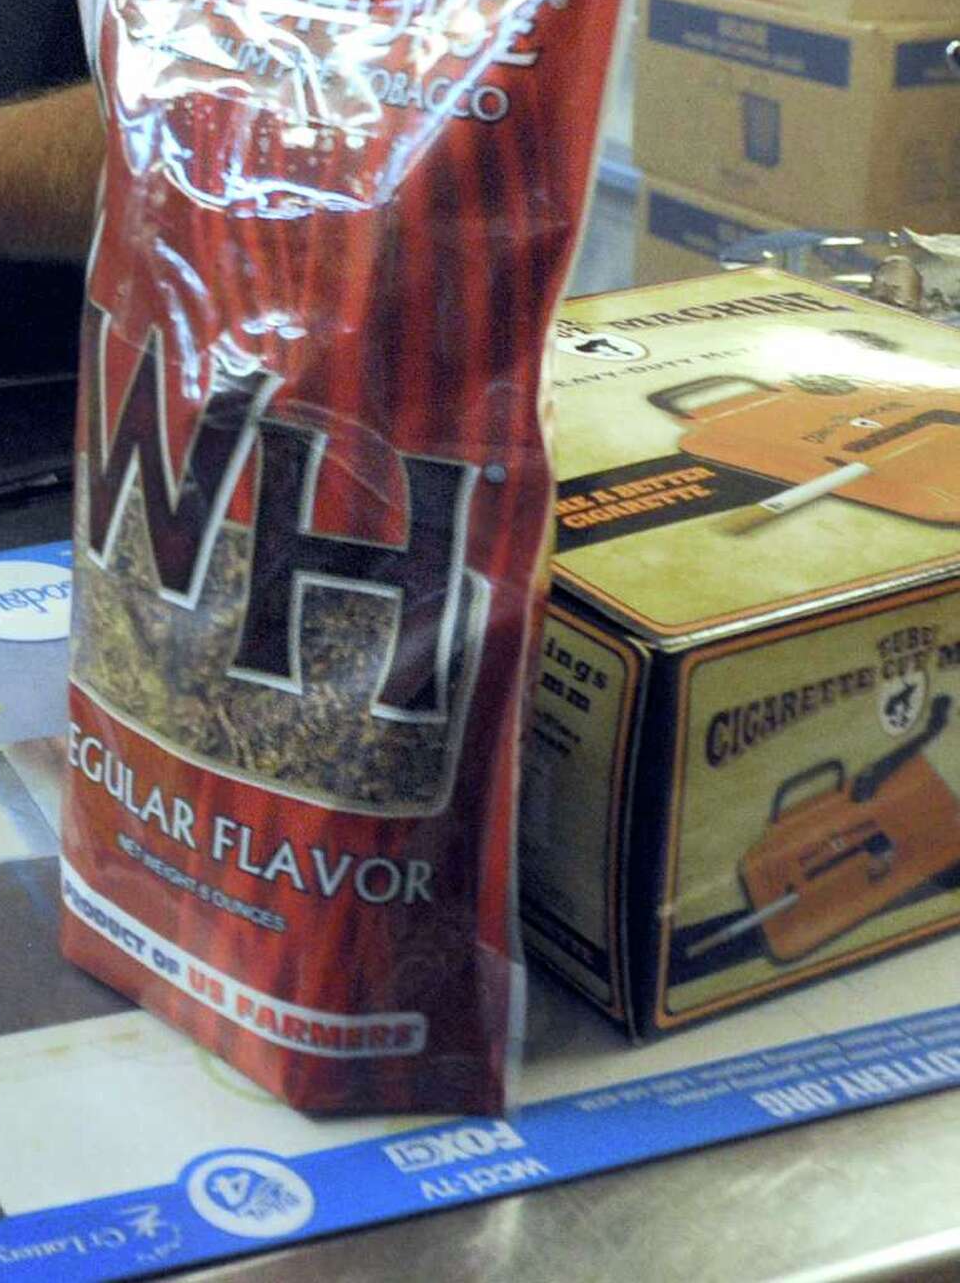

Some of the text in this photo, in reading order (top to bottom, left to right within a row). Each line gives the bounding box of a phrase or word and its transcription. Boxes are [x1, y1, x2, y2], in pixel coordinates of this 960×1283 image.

[373, 69, 509, 121] OBACCO
[610, 292, 854, 332] MACHINE
[617, 466, 717, 502] BETTER
[705, 666, 876, 768] CIGARETTE
[68, 722, 433, 905] EGULAR FLAVOR
[151, 945, 181, 975] OF
[187, 964, 228, 1009] US
[235, 988, 420, 1050] FARMERS
